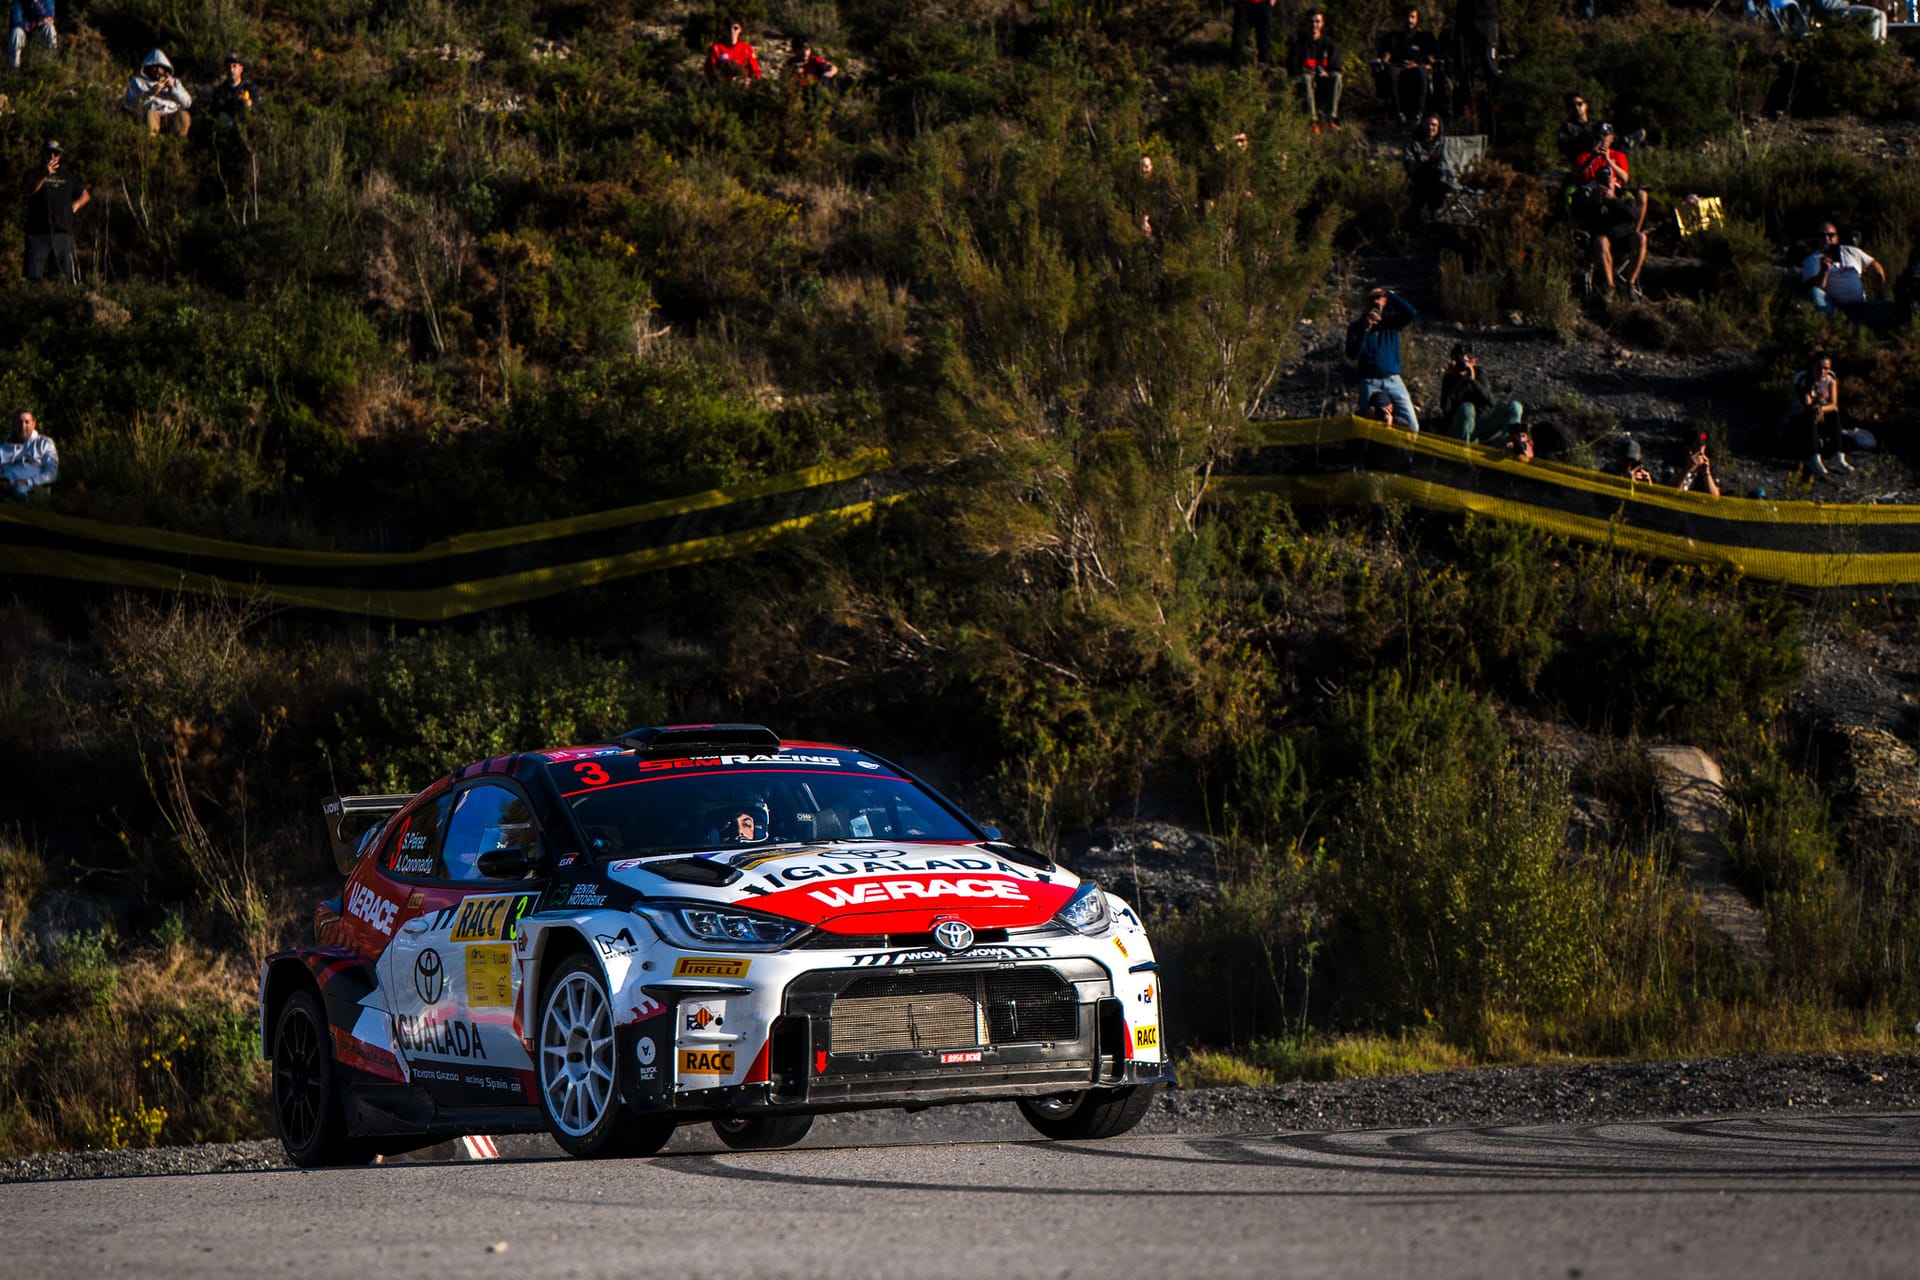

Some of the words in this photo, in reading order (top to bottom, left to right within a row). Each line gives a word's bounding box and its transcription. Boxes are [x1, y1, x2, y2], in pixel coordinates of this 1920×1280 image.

[573, 761, 611, 786] 3
[388, 815, 412, 871] 3
[558, 857, 575, 867] GR
[763, 858, 1030, 889] IGUALADA
[567, 894, 607, 906] MOTORBIKE
[572, 883, 599, 894] RENTAL
[806, 878, 1031, 908] WERACE
[347, 881, 399, 937] WERACE
[455, 899, 506, 938] RACC
[509, 895, 529, 940] 3
[679, 959, 743, 976] PIRELLI
[391, 1012, 488, 1061] IGUALADA
[1137, 1027, 1157, 1047] RACC
[686, 1052, 732, 1071] RACC
[461, 1074, 485, 1088] acing
[485, 1076, 508, 1090] Spain
